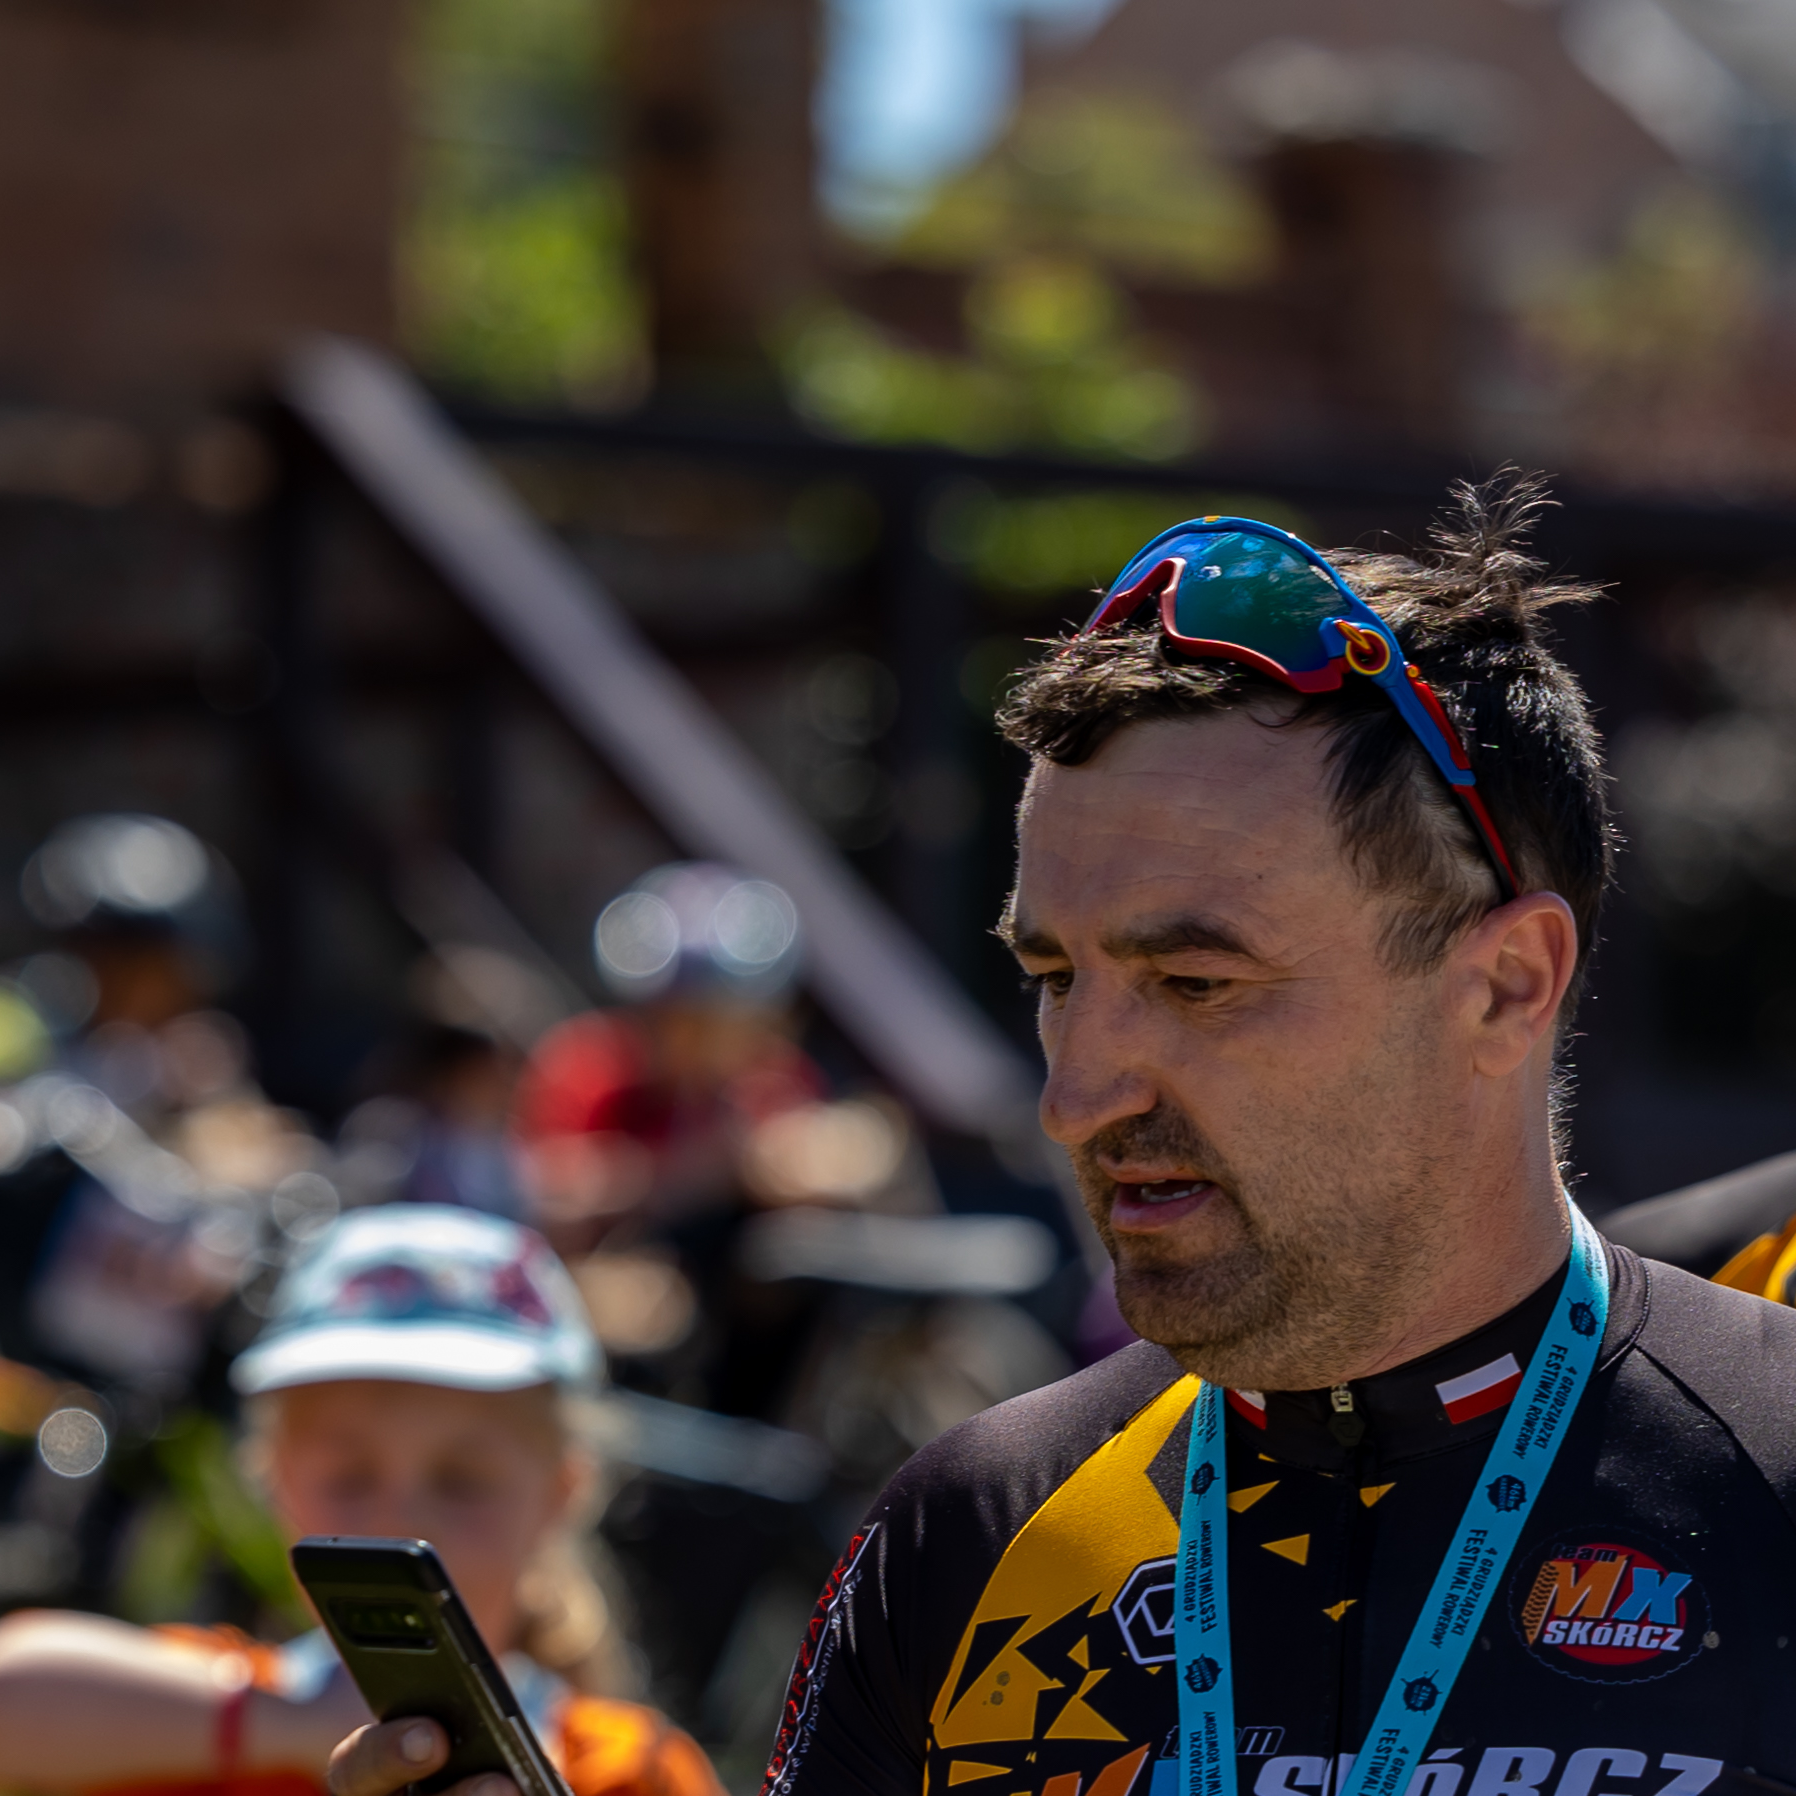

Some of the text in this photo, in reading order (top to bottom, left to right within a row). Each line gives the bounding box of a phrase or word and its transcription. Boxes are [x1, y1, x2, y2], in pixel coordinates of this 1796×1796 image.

[1564, 1364, 1578, 1375] 4
[1512, 1345, 1568, 1458] FESTIWAL ROWEROWY
[1198, 1519, 1217, 1633] FESTIWAL ROWEROWY
[1484, 1545, 1499, 1556] 4
[1428, 1530, 1488, 1648] FESTIWAL ROWEROWY
[1521, 1554, 1693, 1646] MX
[1202, 1711, 1220, 1764] ROWEROWY
[1363, 1729, 1400, 1790] FESTIWAL
[1396, 1743, 1410, 1755] 4
